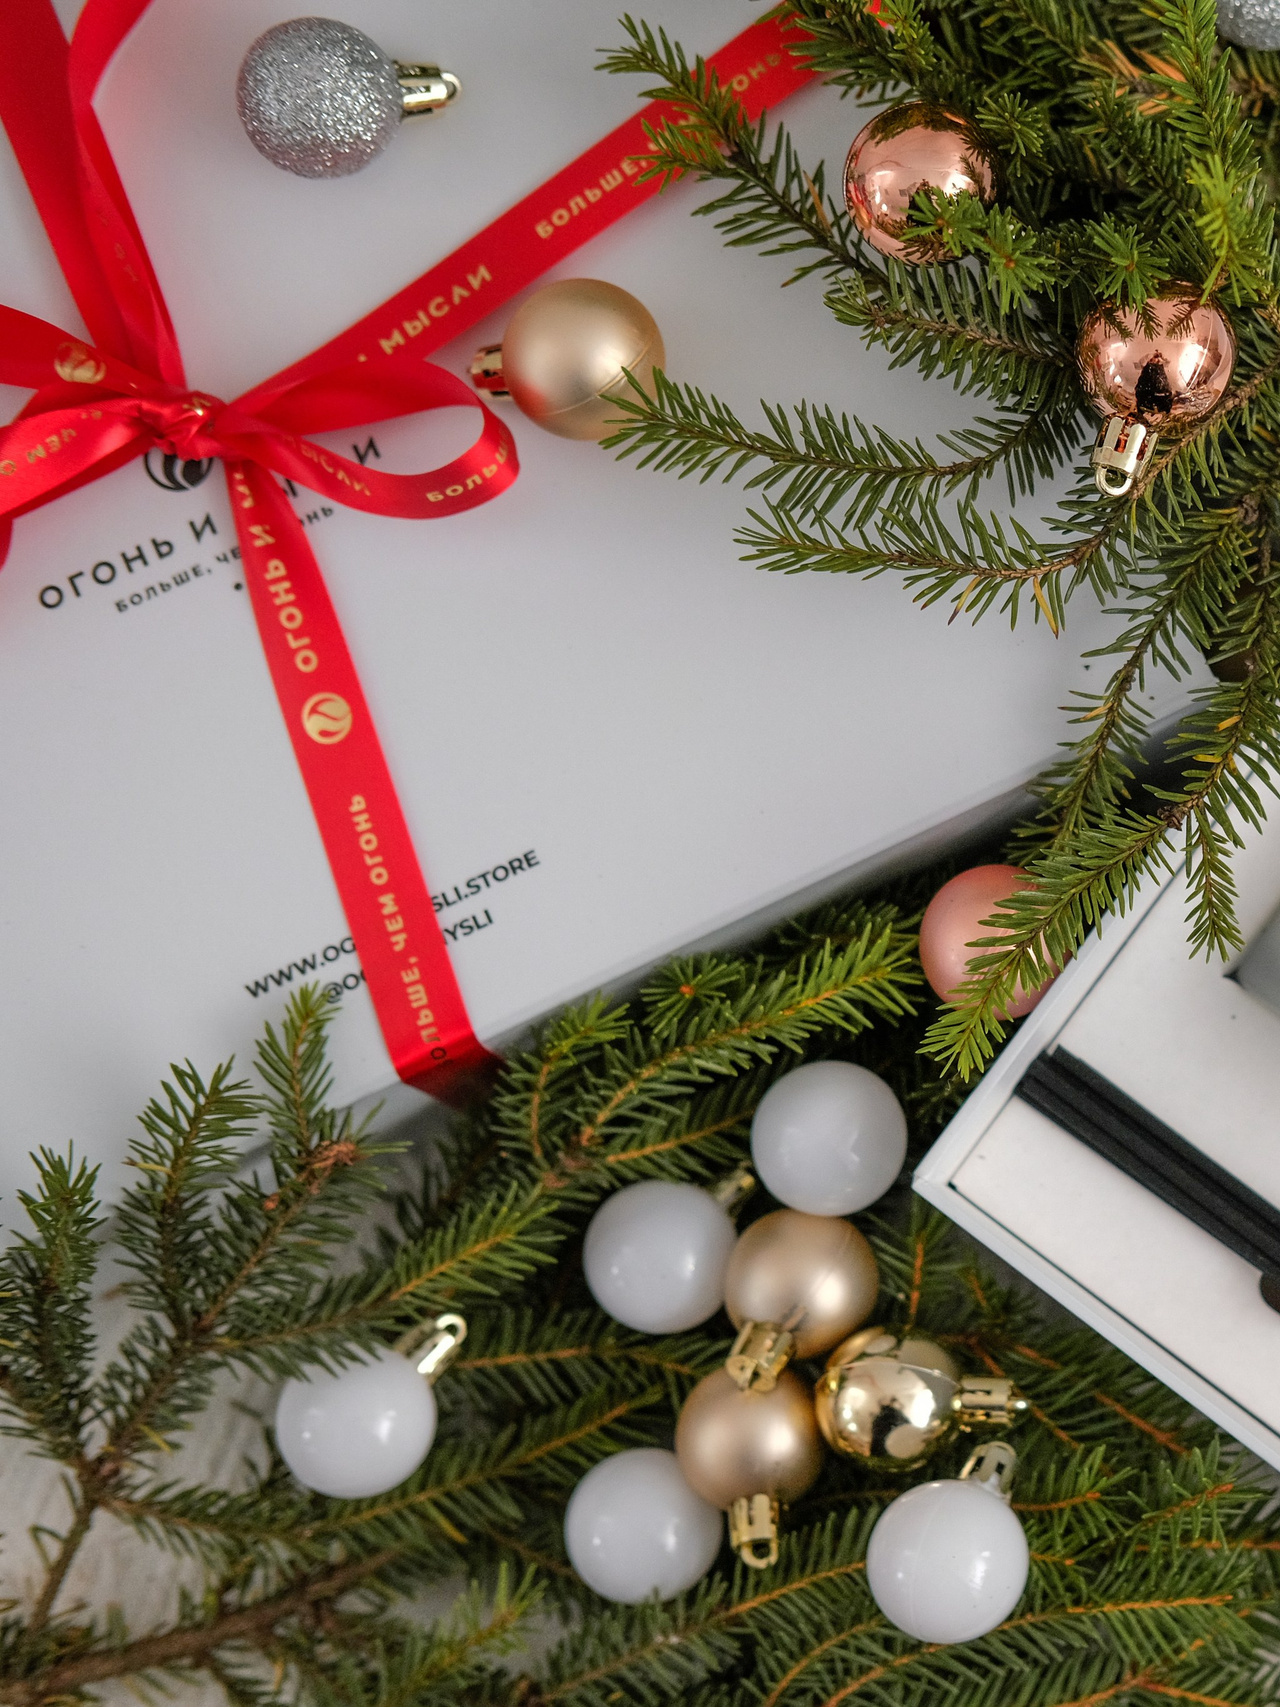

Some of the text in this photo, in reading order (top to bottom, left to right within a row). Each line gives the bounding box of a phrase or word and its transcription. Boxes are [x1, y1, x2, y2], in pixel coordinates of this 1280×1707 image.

[380, 264, 492, 355] МЫСЛИ
[425, 439, 508, 502] БОЛЬШ
[39, 513, 218, 609] ОГОНЬ И
[249, 524, 276, 548] И
[115, 546, 241, 613] БОЛЬШЕ, ЧЕ
[265, 559, 319, 673] ОГОНЬ
[348, 794, 389, 886] ОГОНЬ
[378, 893, 408, 952] ЧЕМ
